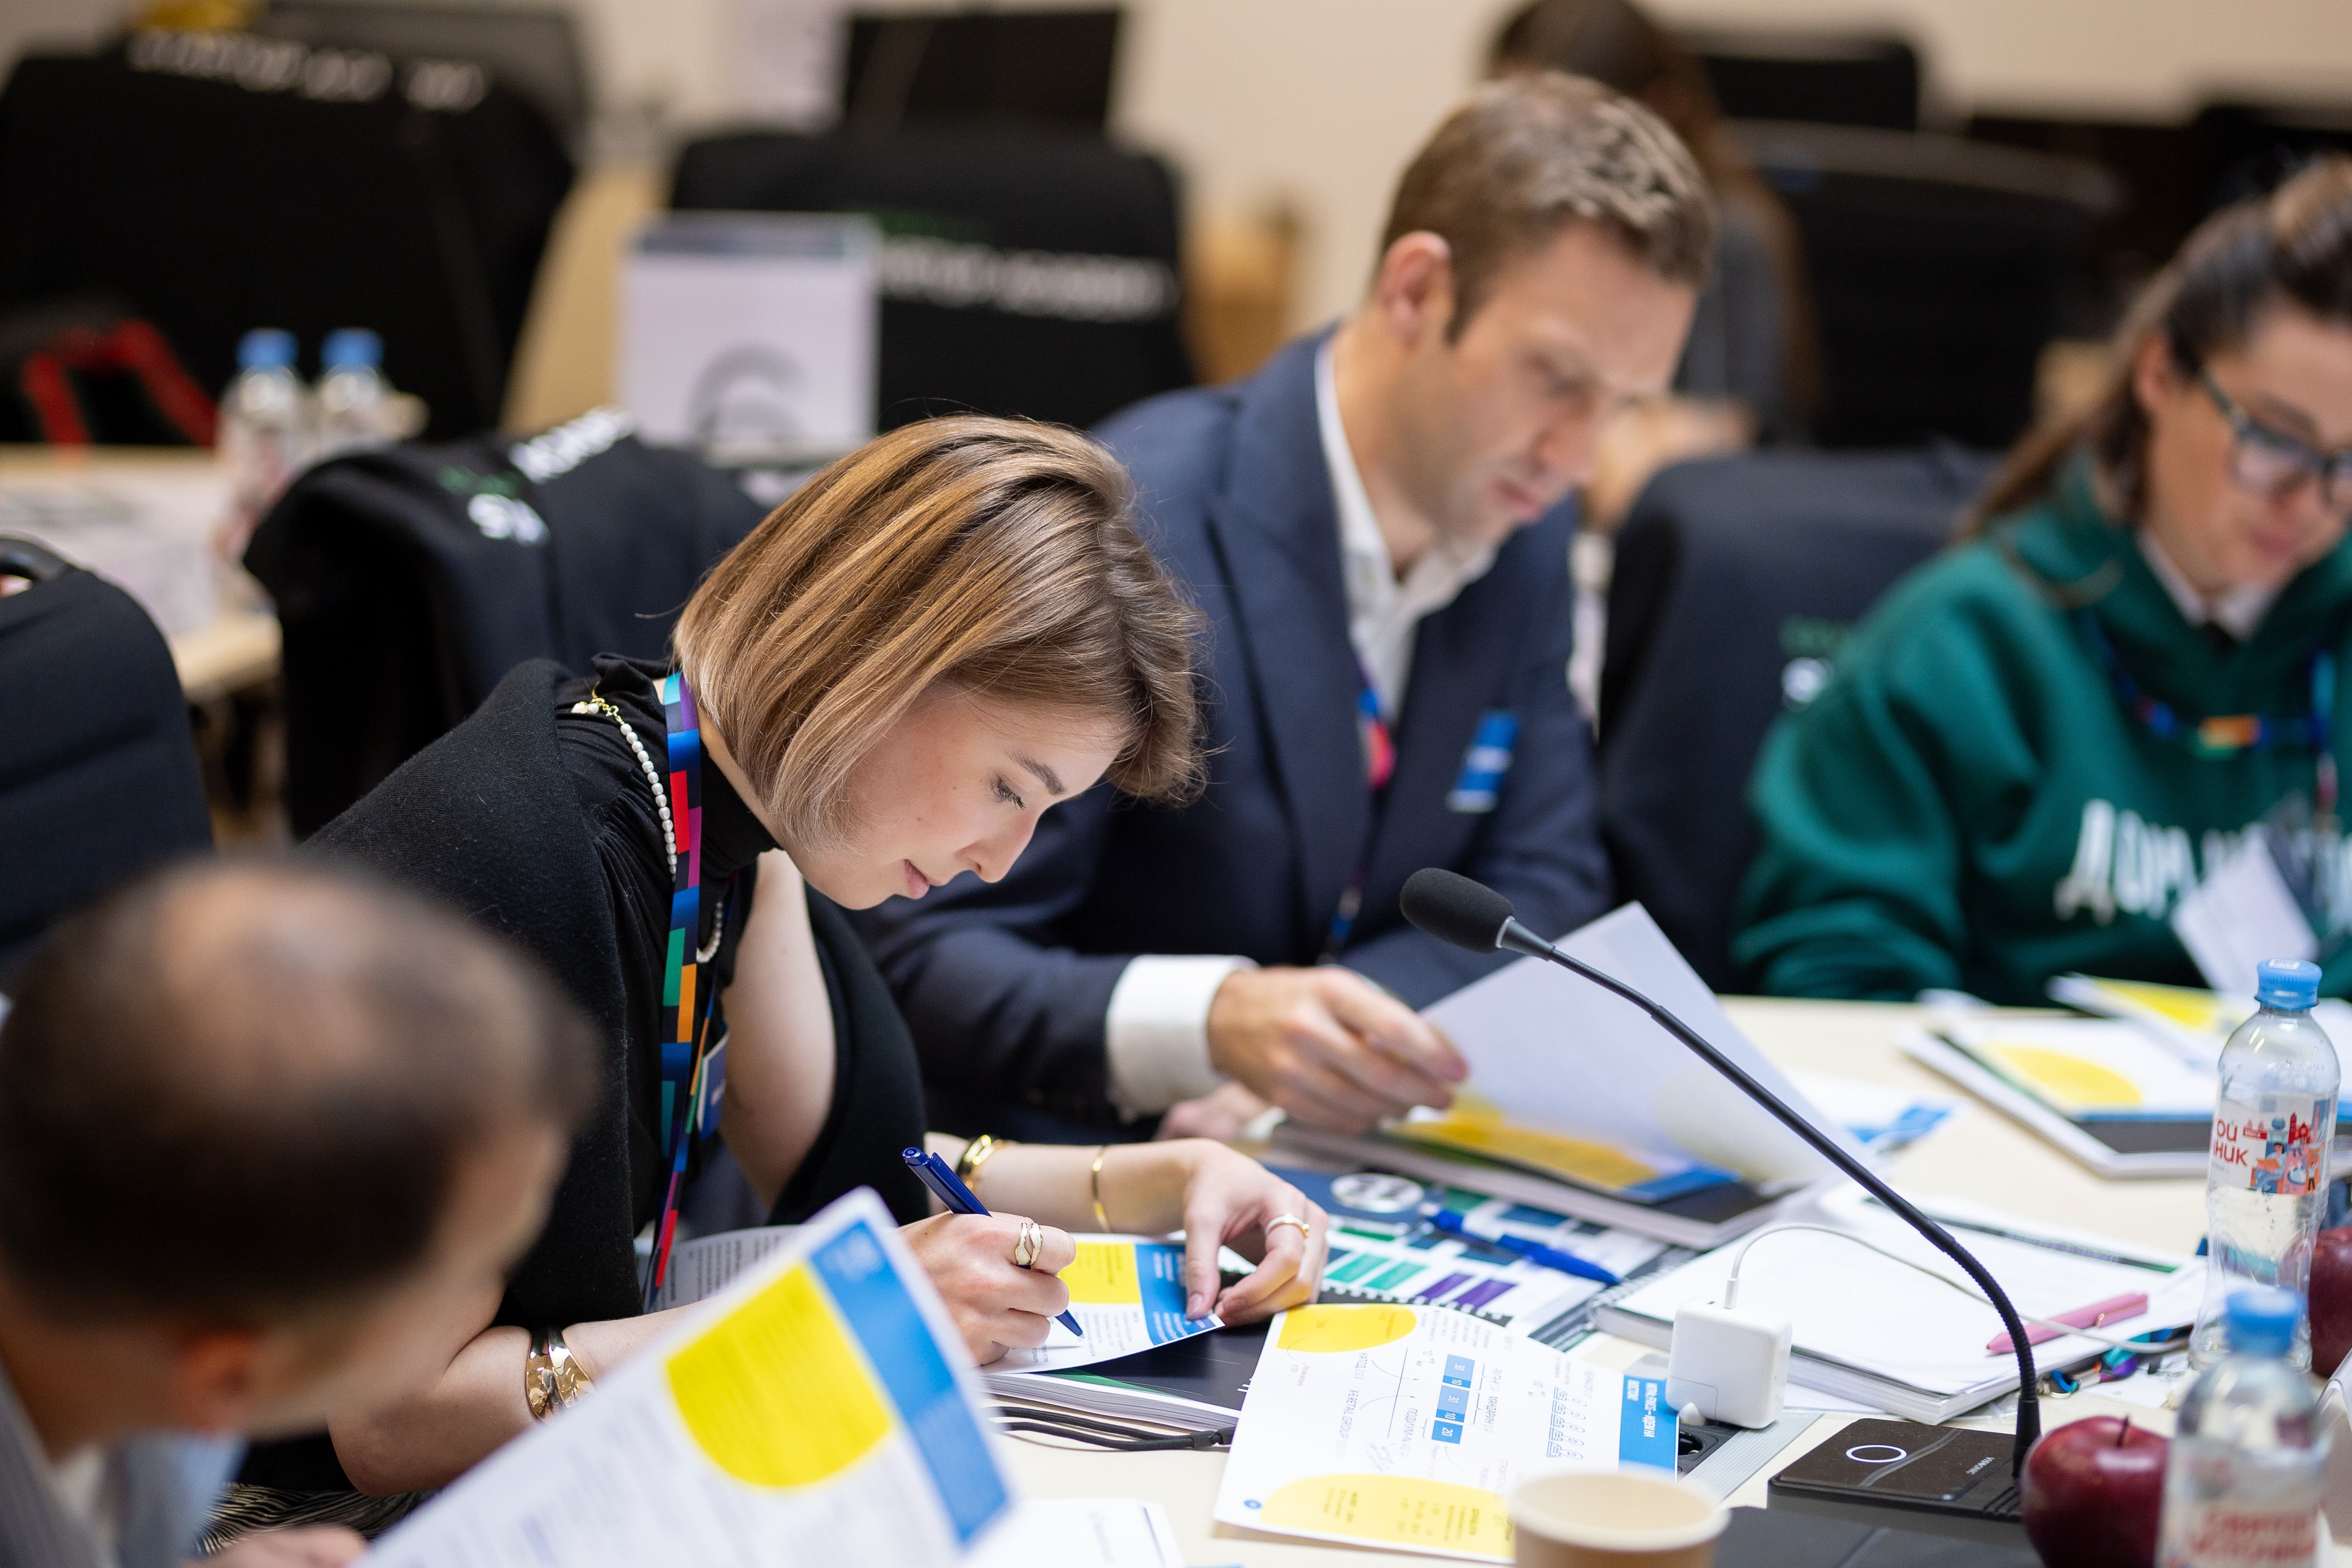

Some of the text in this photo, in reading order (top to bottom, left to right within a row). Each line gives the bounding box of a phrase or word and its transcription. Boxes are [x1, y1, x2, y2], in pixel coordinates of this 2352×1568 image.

[1355, 1353, 1368, 1368] КАТОД
[1344, 1397, 1357, 1415] RETAIL
[1448, 1395, 1459, 1403] 30
[1485, 1396, 1498, 1424] МАНДАРИН
[1339, 1417, 1352, 1439] GROUP
[1441, 1427, 1454, 1437] 20
[1643, 1429, 1655, 1437] НА
